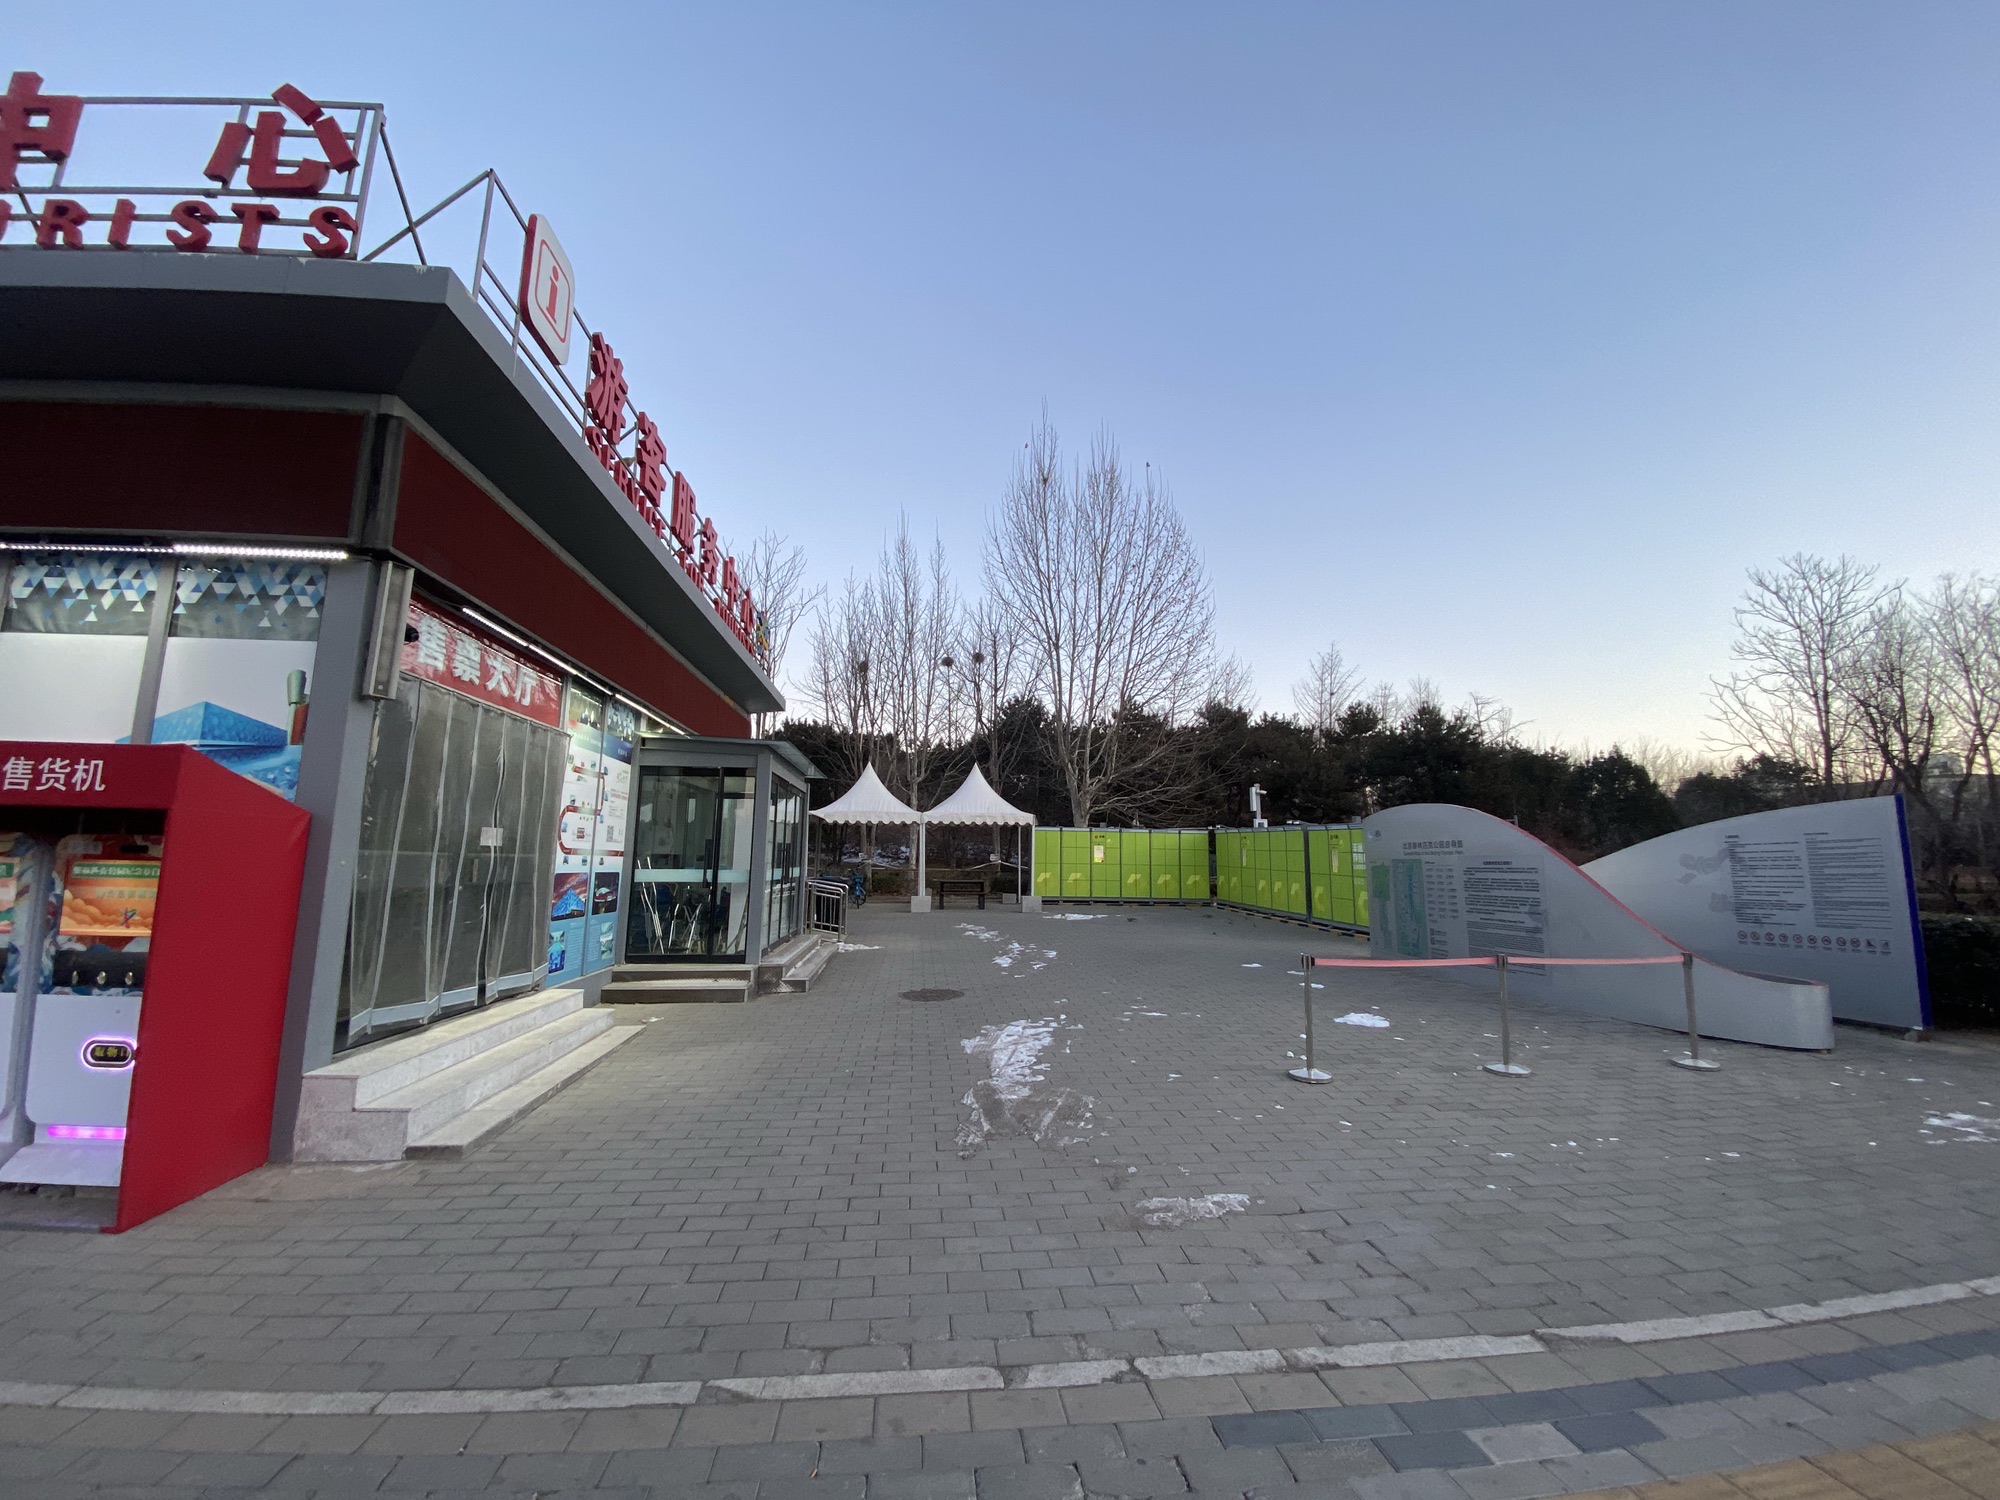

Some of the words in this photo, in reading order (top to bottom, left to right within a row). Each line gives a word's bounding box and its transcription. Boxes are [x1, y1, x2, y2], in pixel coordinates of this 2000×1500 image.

[0, 198, 358, 259] RISTS
[585, 331, 756, 636] 游客服务中心
[417, 615, 540, 707] 售票大厅
[2, 756, 107, 791] 售货机
